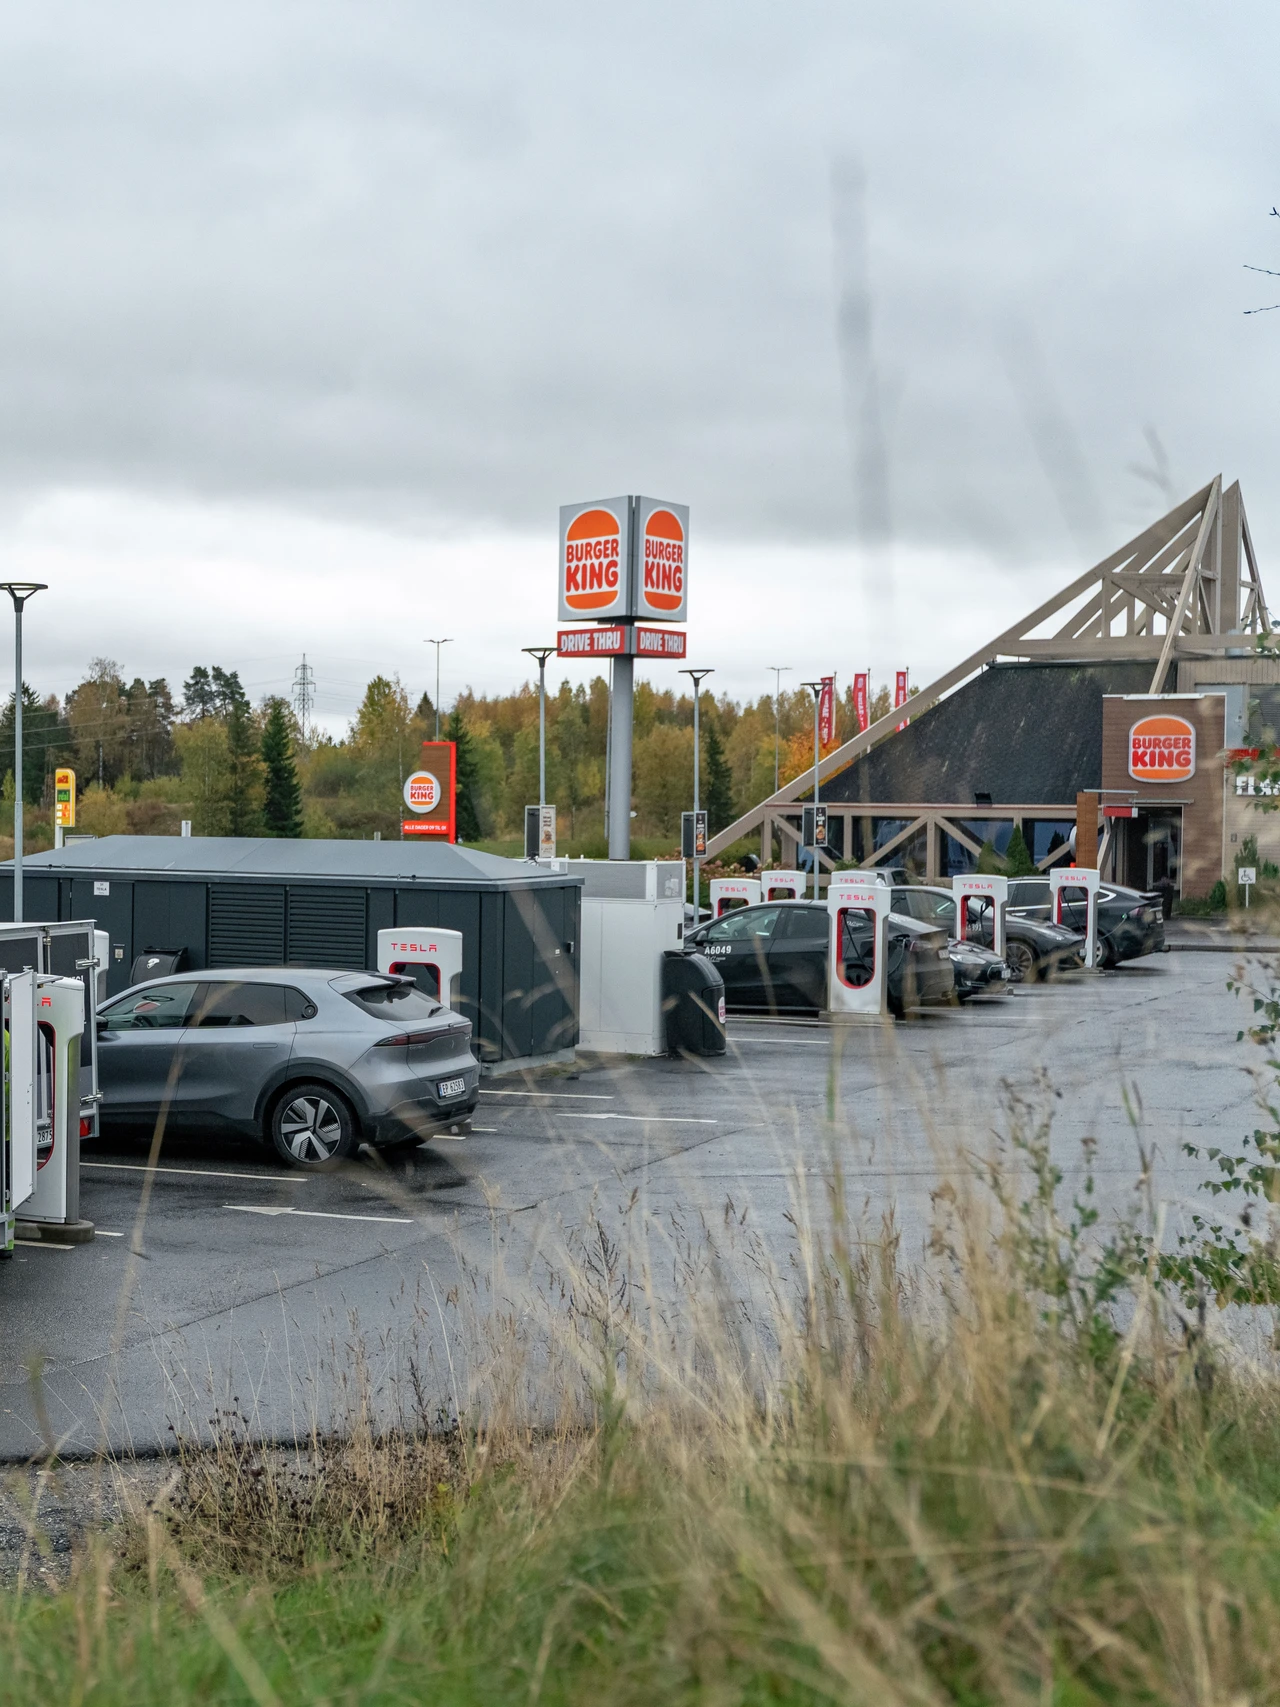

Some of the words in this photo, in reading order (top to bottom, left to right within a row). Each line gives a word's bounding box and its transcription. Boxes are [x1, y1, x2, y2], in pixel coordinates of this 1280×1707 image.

[566, 538, 620, 563] BURGER
[645, 539, 683, 564] BURGER
[565, 560, 619, 592] KING
[644, 560, 683, 593] KING
[561, 633, 590, 652] DRIVE
[593, 631, 620, 651] THRU
[640, 632, 663, 651] DRIVE
[664, 634, 683, 653] THRU
[1132, 737, 1191, 749] BURGER
[1132, 750, 1191, 768] KING
[410, 792, 434, 800] KING
[391, 943, 437, 952] TESLA
[704, 945, 732, 954] A6049
[442, 1084, 449, 1095] EP
[37, 1130, 52, 1142] 2875
